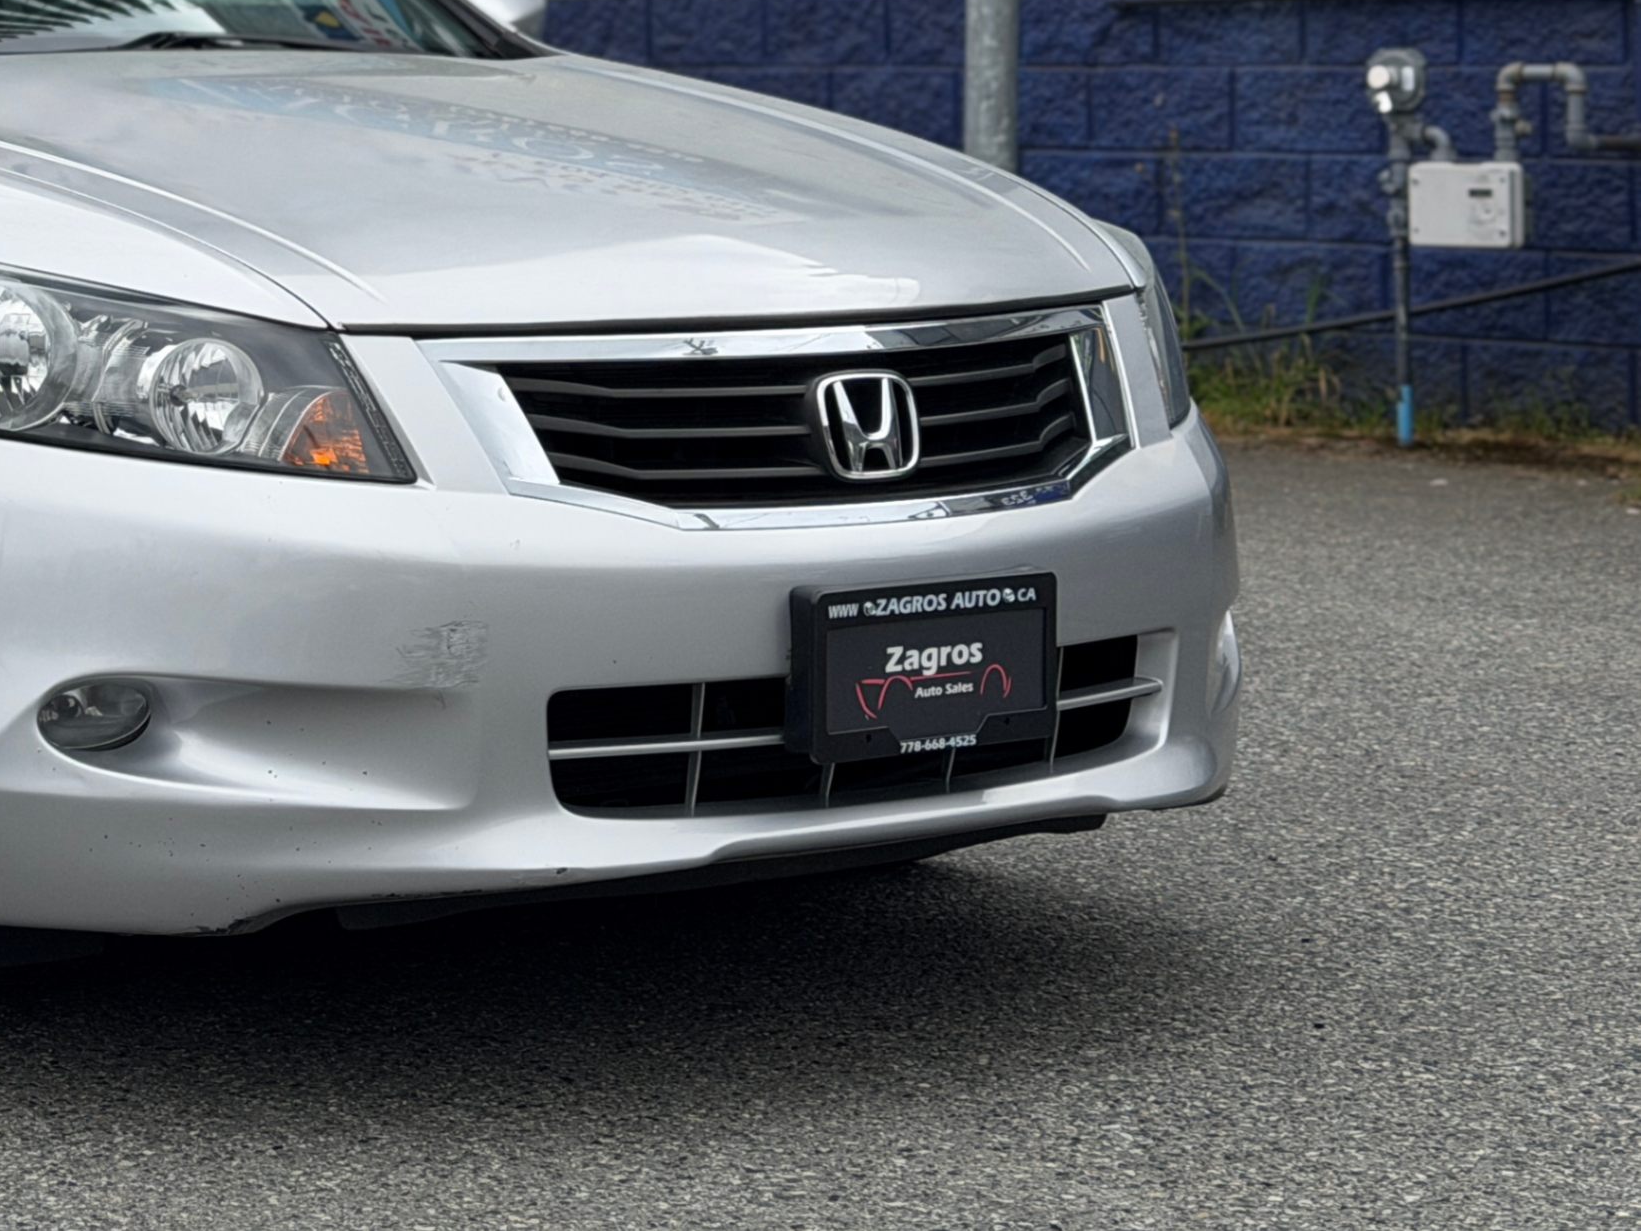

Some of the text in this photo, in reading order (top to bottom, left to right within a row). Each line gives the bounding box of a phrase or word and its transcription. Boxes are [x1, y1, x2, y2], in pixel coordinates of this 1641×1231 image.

[875, 593, 947, 617] ZAGROS
[885, 642, 983, 676] Zagros
[914, 682, 974, 699] Auto Sales
[899, 734, 977, 754] 778-668-4525
